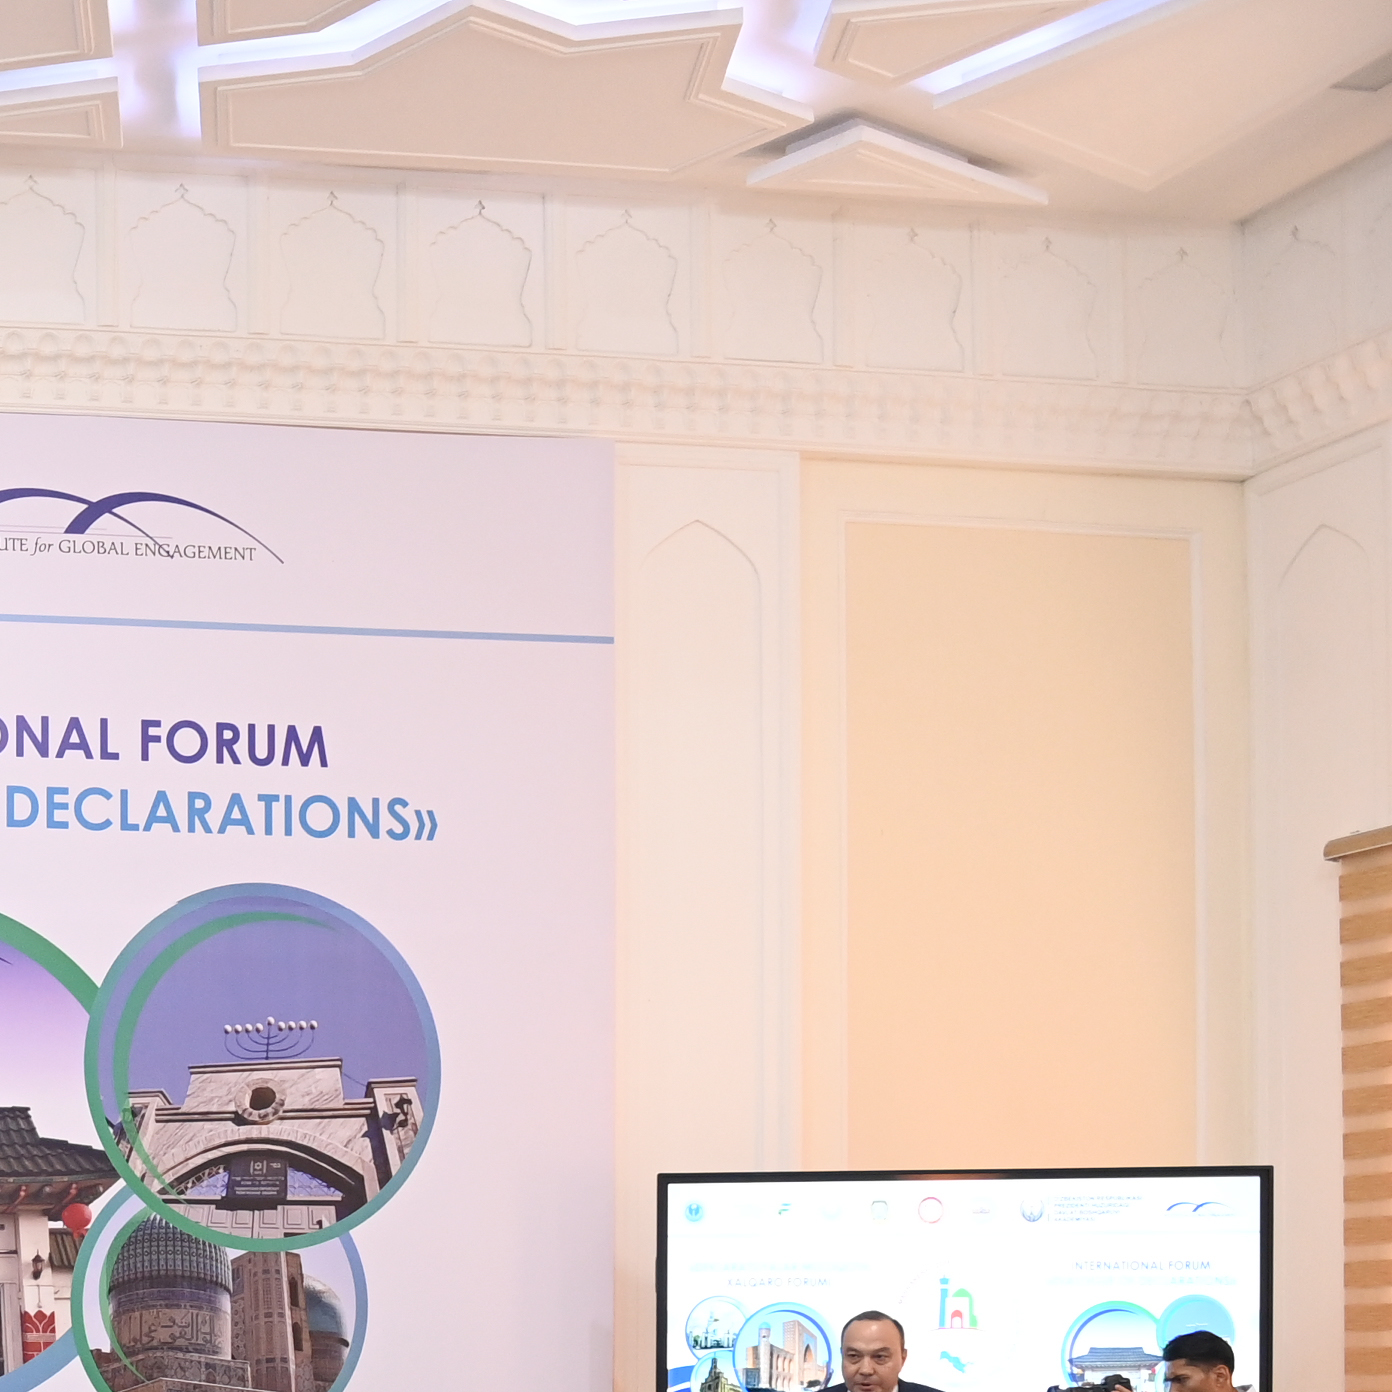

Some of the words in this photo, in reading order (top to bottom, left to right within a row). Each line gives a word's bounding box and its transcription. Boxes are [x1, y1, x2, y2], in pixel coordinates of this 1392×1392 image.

[30, 537, 54, 557] for
[58, 539, 130, 557] GLOBAL
[134, 542, 256, 561] ENGAGEMENT
[140, 719, 330, 769] FORUM
[5, 785, 439, 843] DECLARATIONS»
[1072, 1261, 1164, 1270] INTERNATIONAL
[1168, 1261, 1211, 1270] FORUM
[727, 1277, 783, 1288] XALQARO
[787, 1277, 832, 1287] FORUMI
